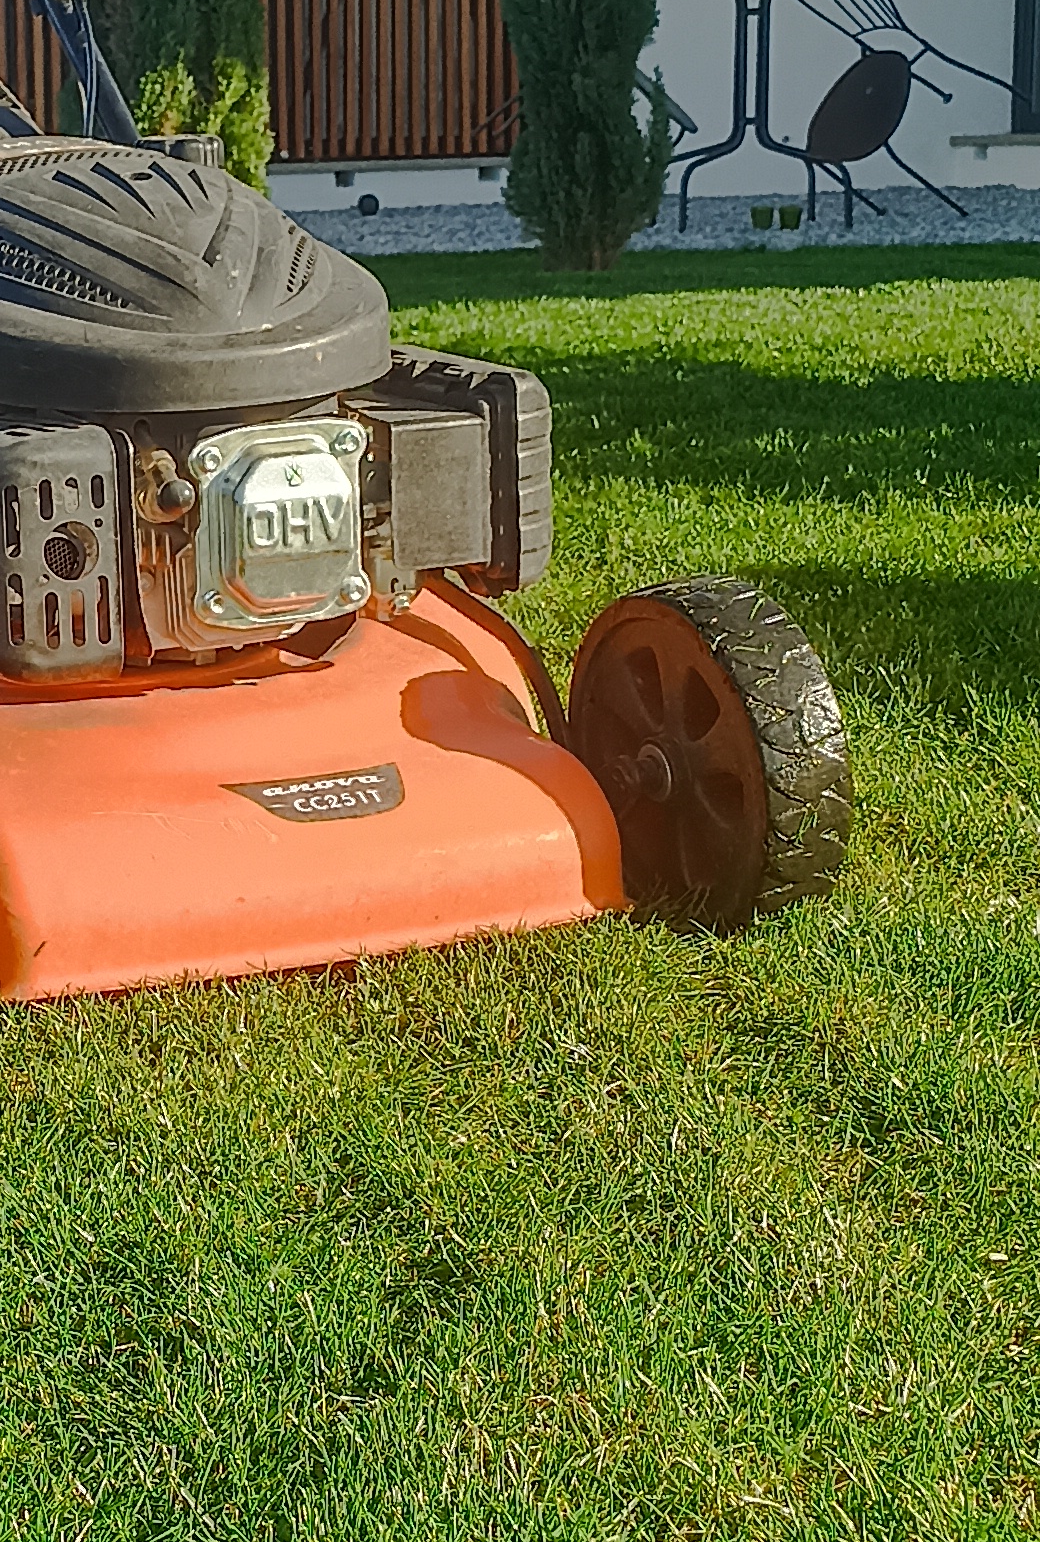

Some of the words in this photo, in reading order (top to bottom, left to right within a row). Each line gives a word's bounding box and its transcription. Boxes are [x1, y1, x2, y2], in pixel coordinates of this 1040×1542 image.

[245, 493, 347, 548] OHV
[262, 774, 386, 797] anova
[293, 788, 382, 813] CC251T
